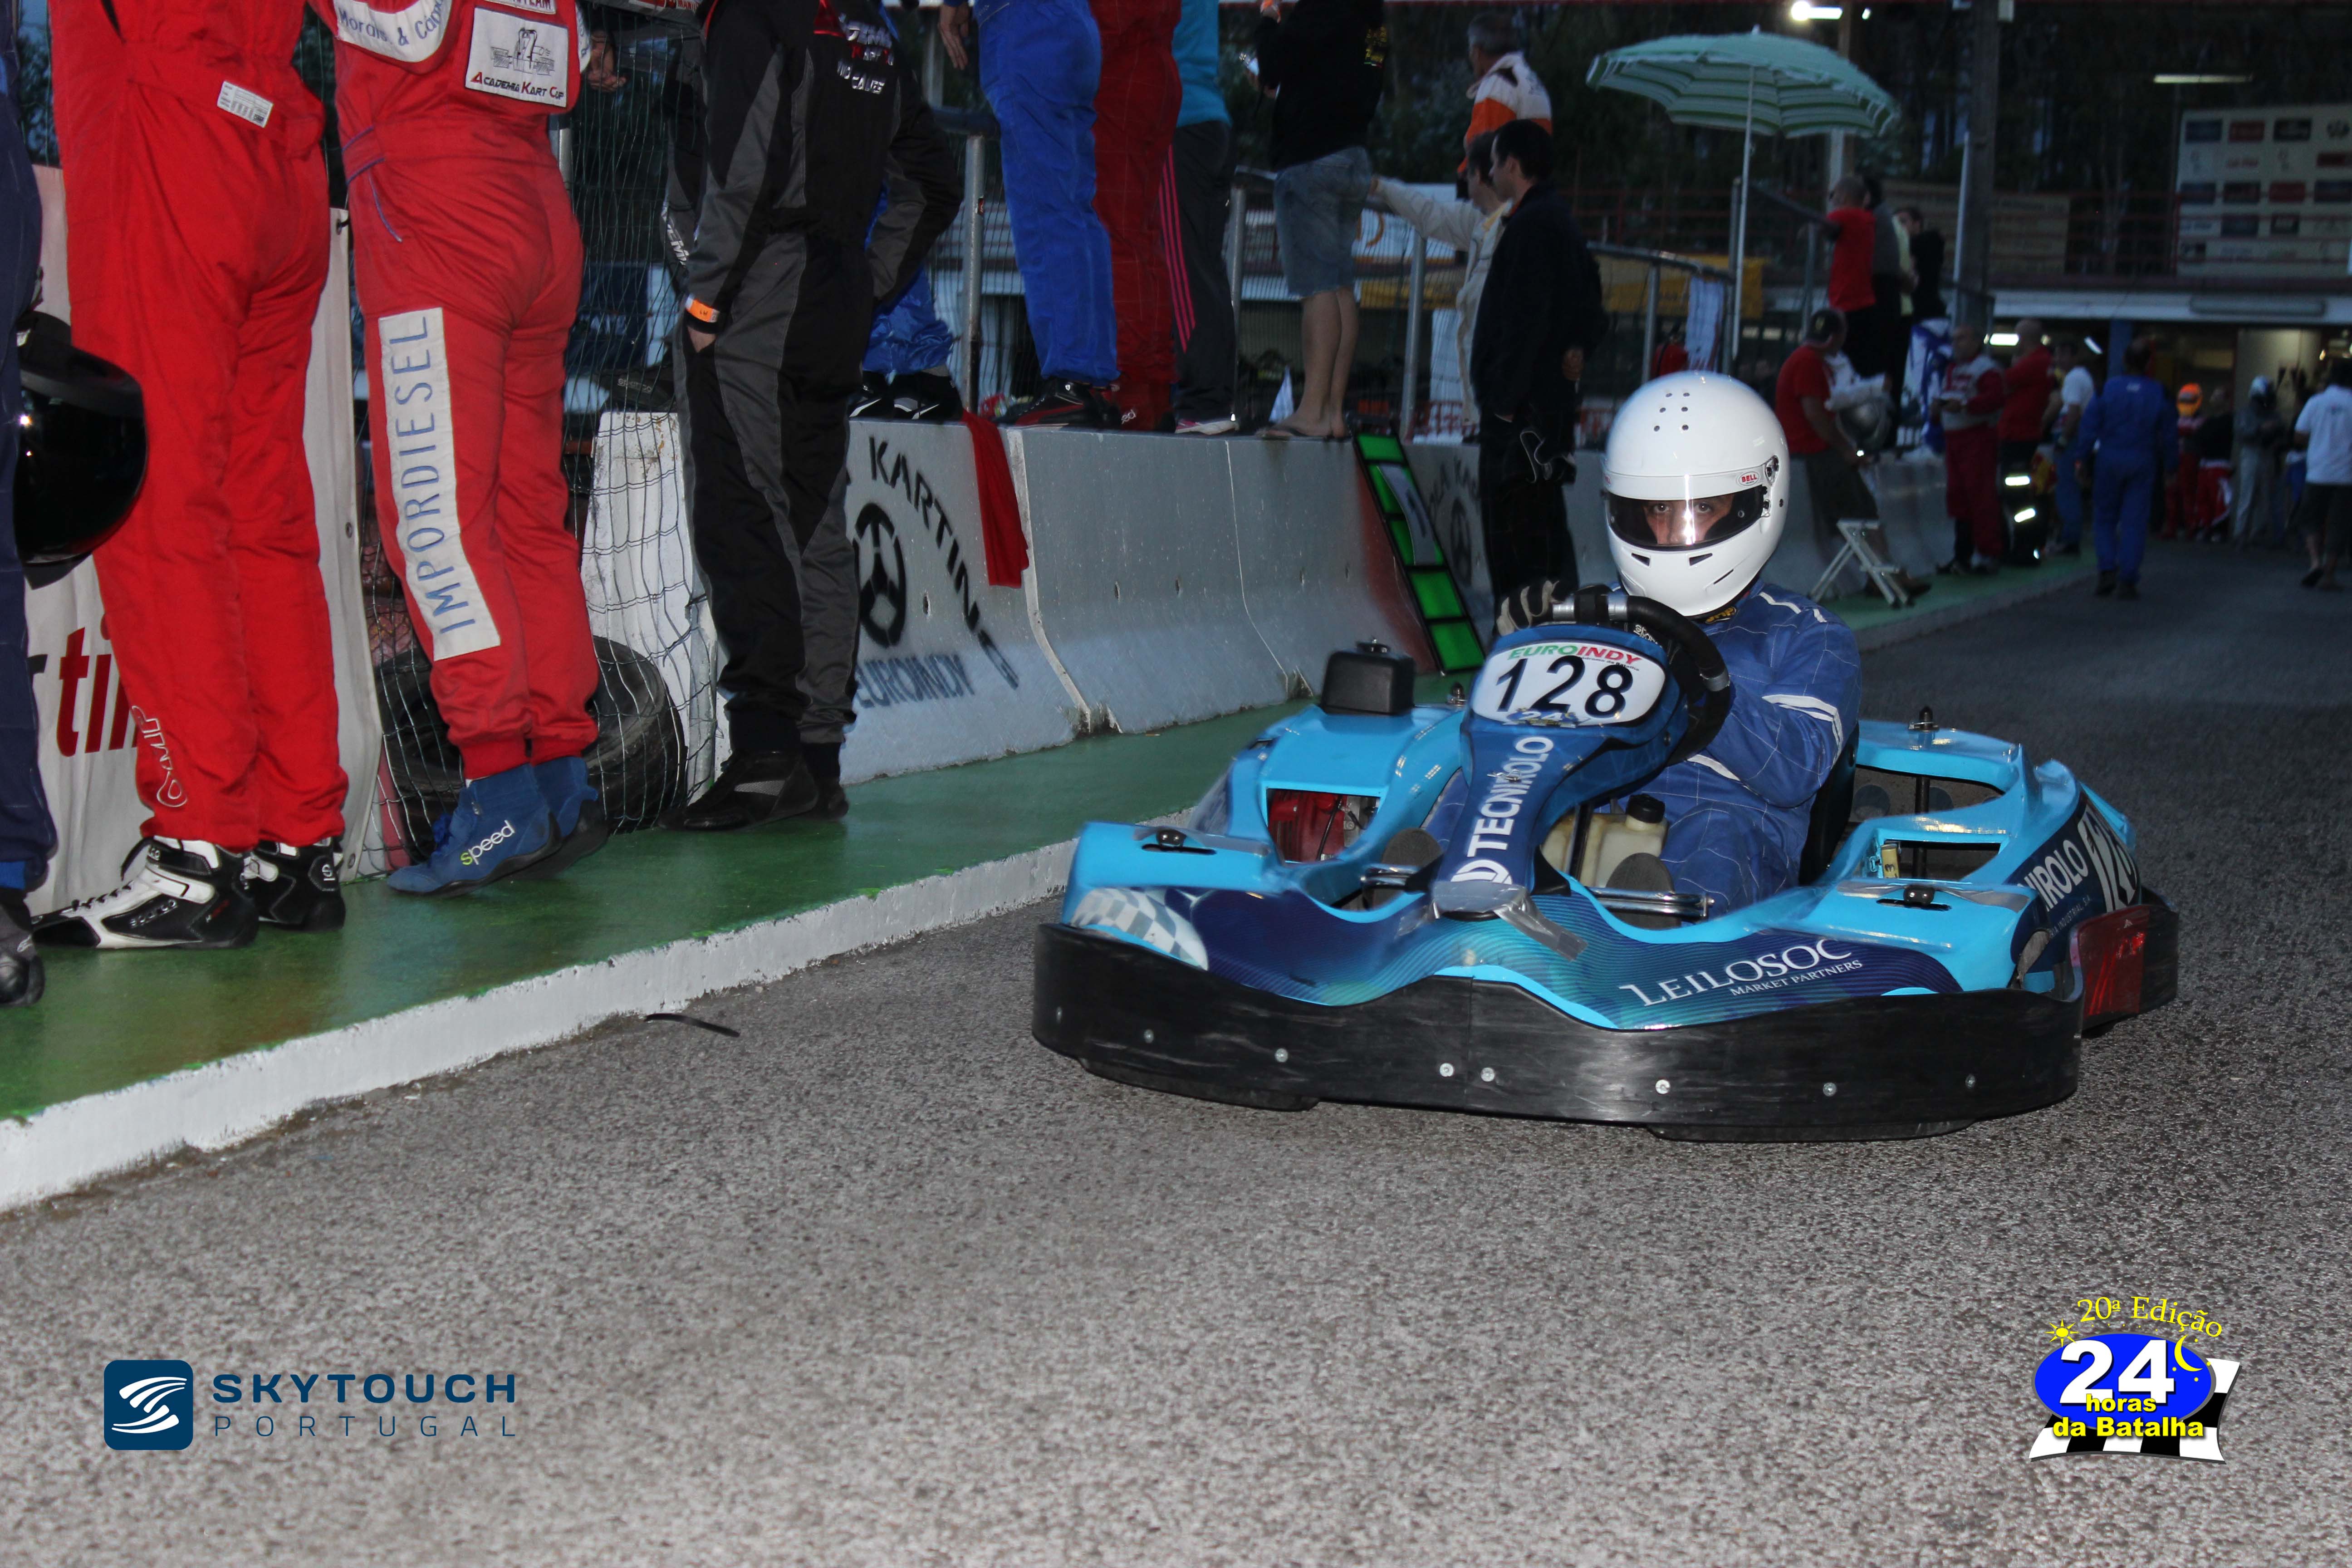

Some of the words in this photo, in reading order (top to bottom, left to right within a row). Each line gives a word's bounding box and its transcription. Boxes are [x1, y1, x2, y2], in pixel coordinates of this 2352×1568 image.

[470, 72, 520, 92] ACADEMIA
[521, 82, 547, 96] KART
[549, 87, 564, 99] CUP
[389, 317, 476, 634] IMPORDIESEL
[1741, 474, 1757, 482] BELL
[1508, 644, 1642, 665] EUROINDY
[1495, 656, 1633, 718] 128
[460, 820, 515, 865] speed
[1619, 939, 1852, 1006] LEILOSOC
[1730, 978, 1789, 996] MARKET
[1790, 959, 1863, 985] PARTNERS
